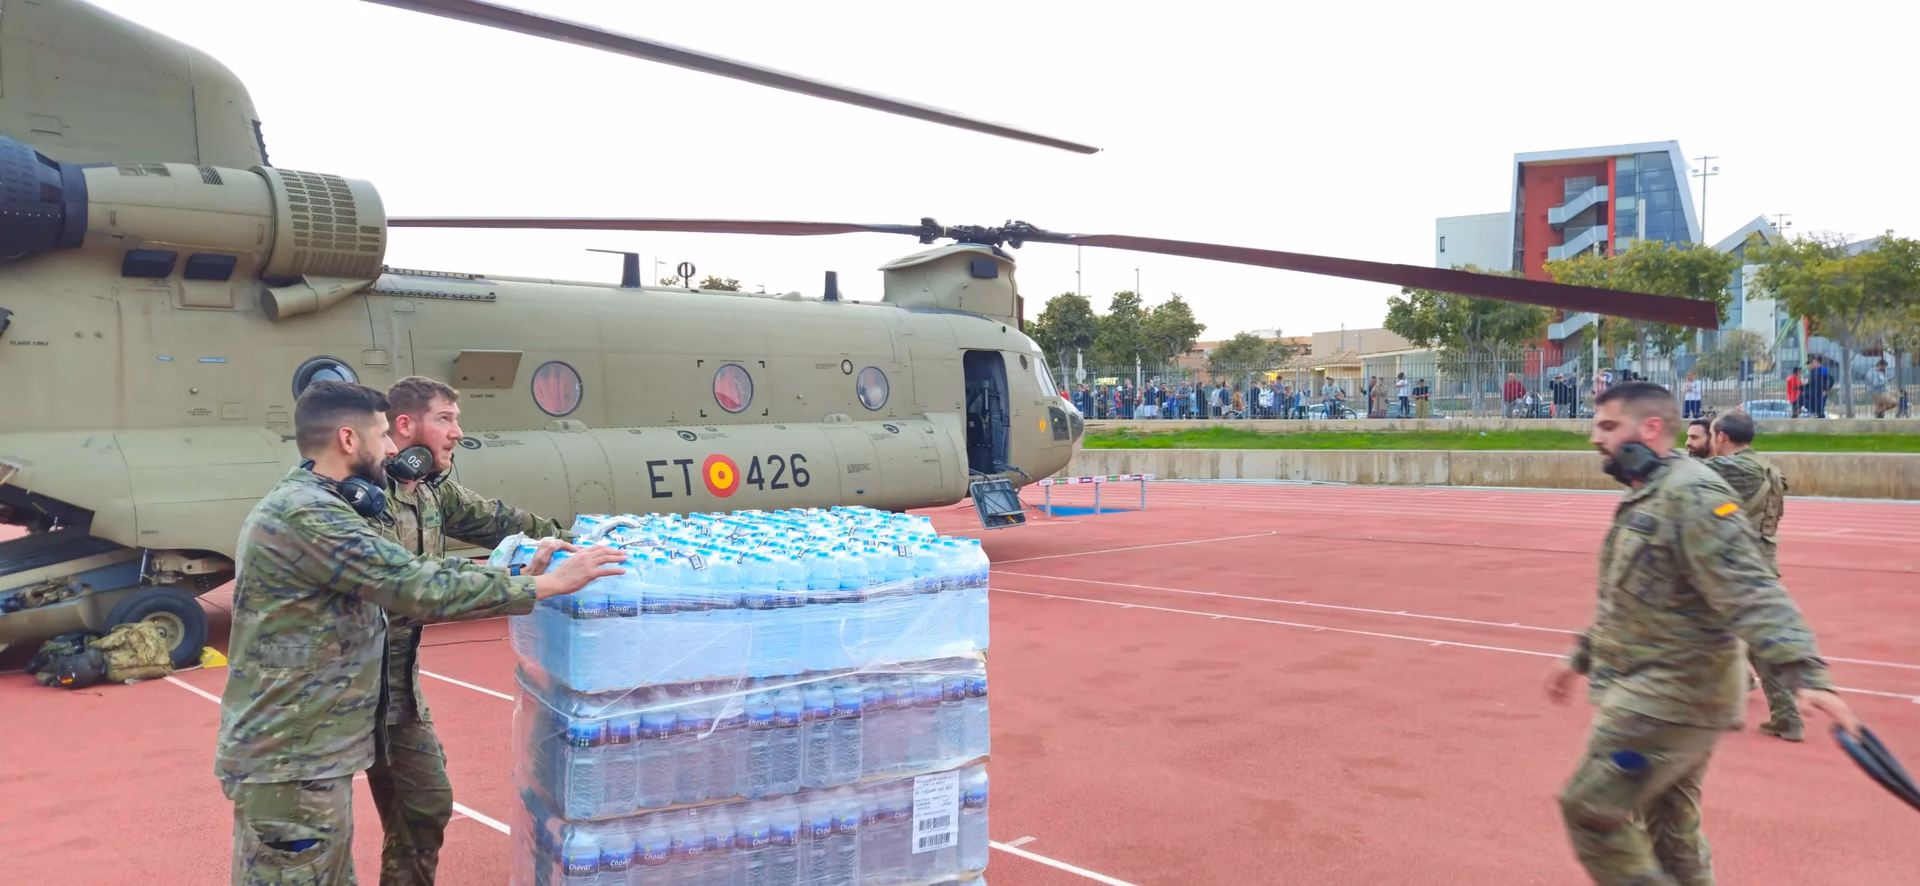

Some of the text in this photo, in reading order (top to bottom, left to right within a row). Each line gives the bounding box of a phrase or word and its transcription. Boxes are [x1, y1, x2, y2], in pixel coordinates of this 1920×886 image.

[407, 455, 422, 468] 05
[646, 453, 811, 499] ET 426
